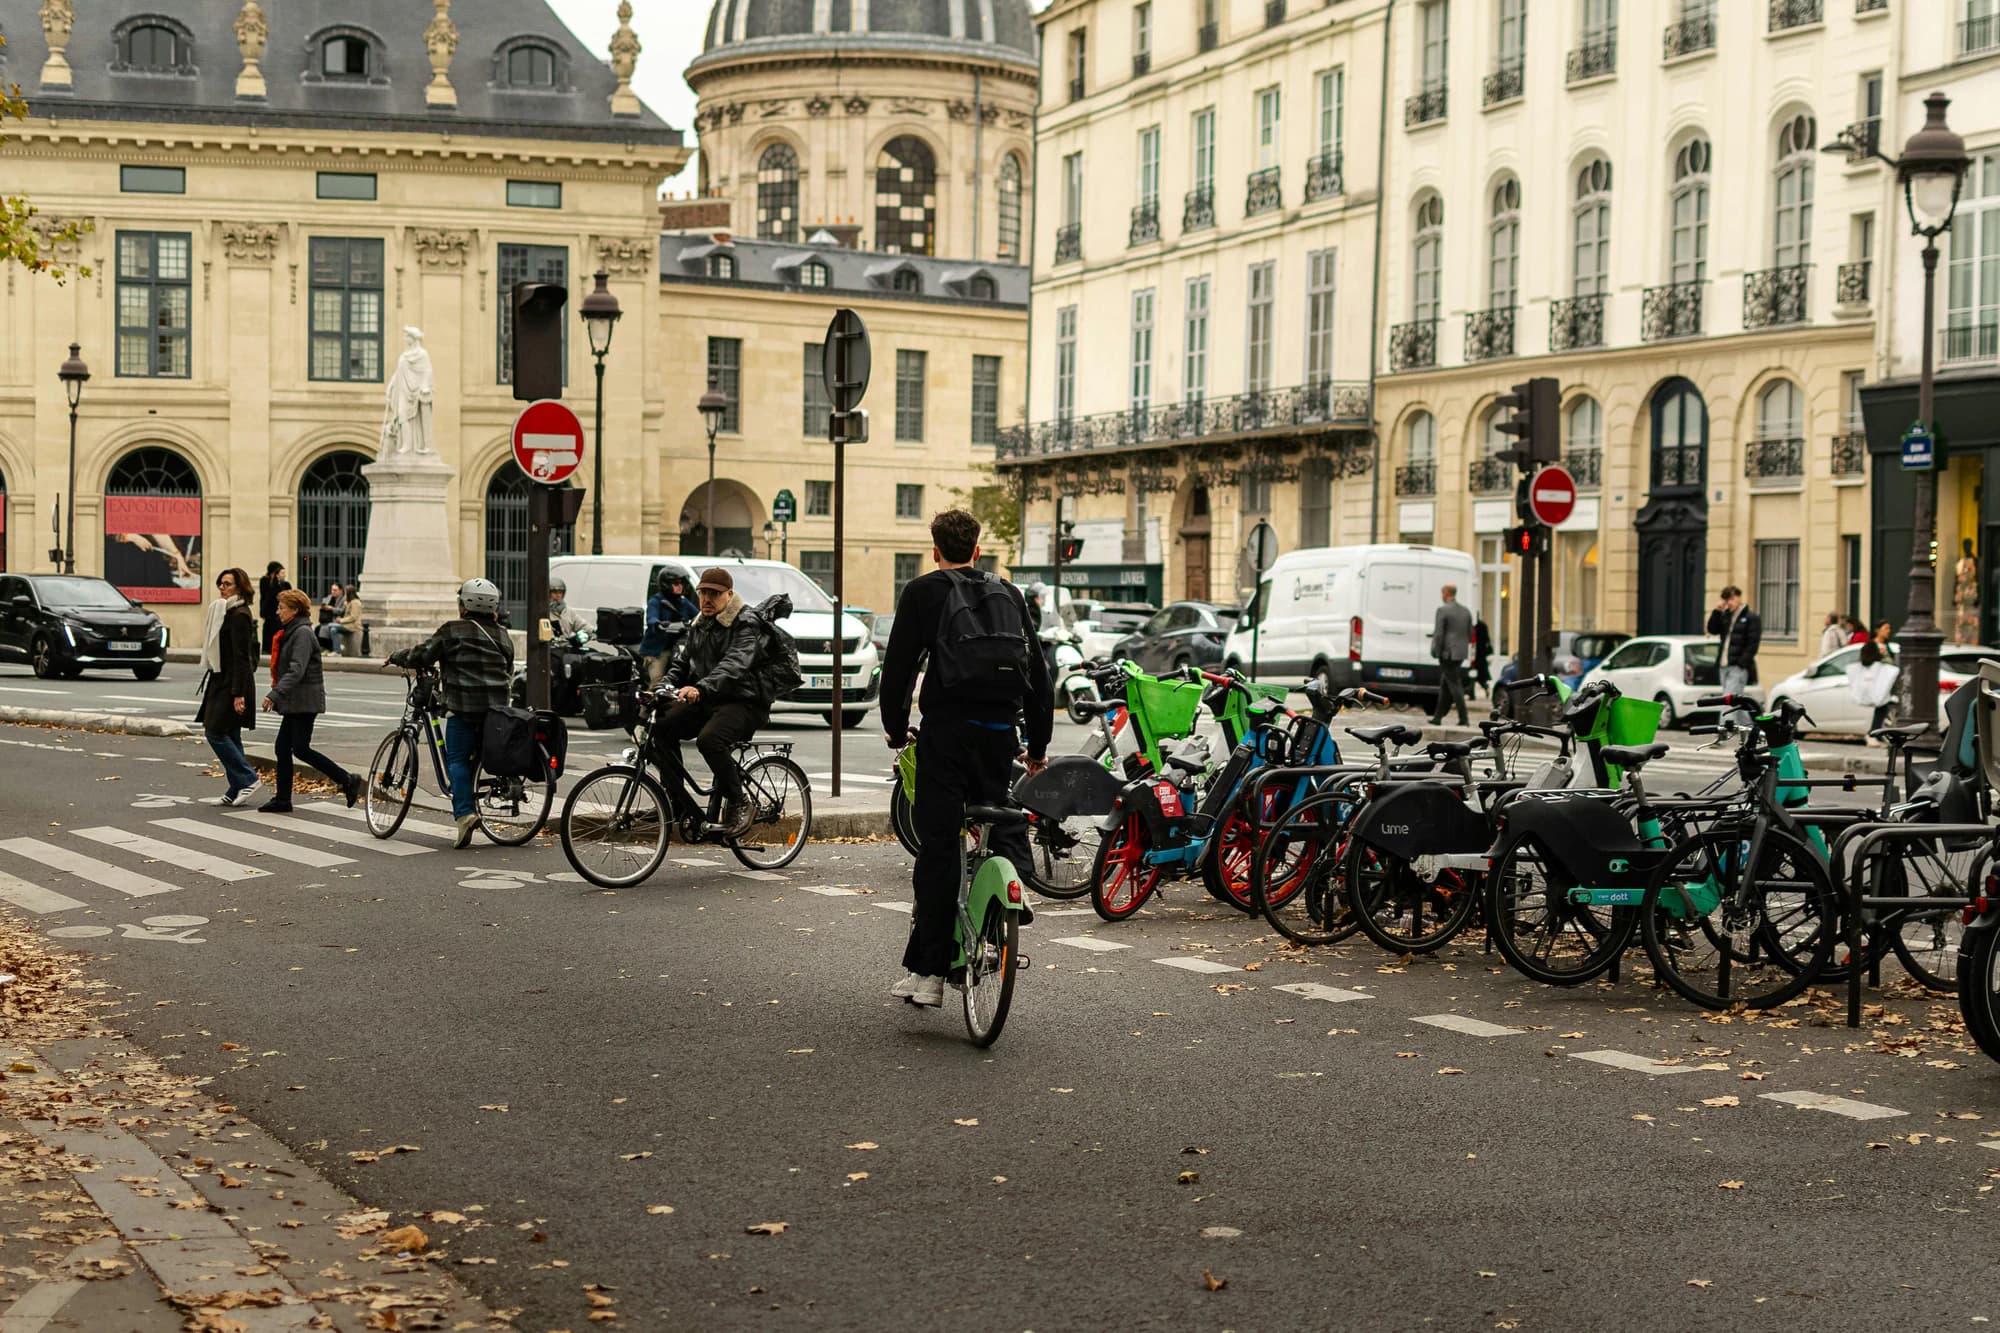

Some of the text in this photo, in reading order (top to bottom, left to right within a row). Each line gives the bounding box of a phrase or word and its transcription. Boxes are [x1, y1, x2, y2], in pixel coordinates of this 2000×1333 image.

[109, 499, 197, 513] EXPOSITION
[1120, 571, 1146, 585] LIVRES
[1610, 893, 1629, 901] dott
